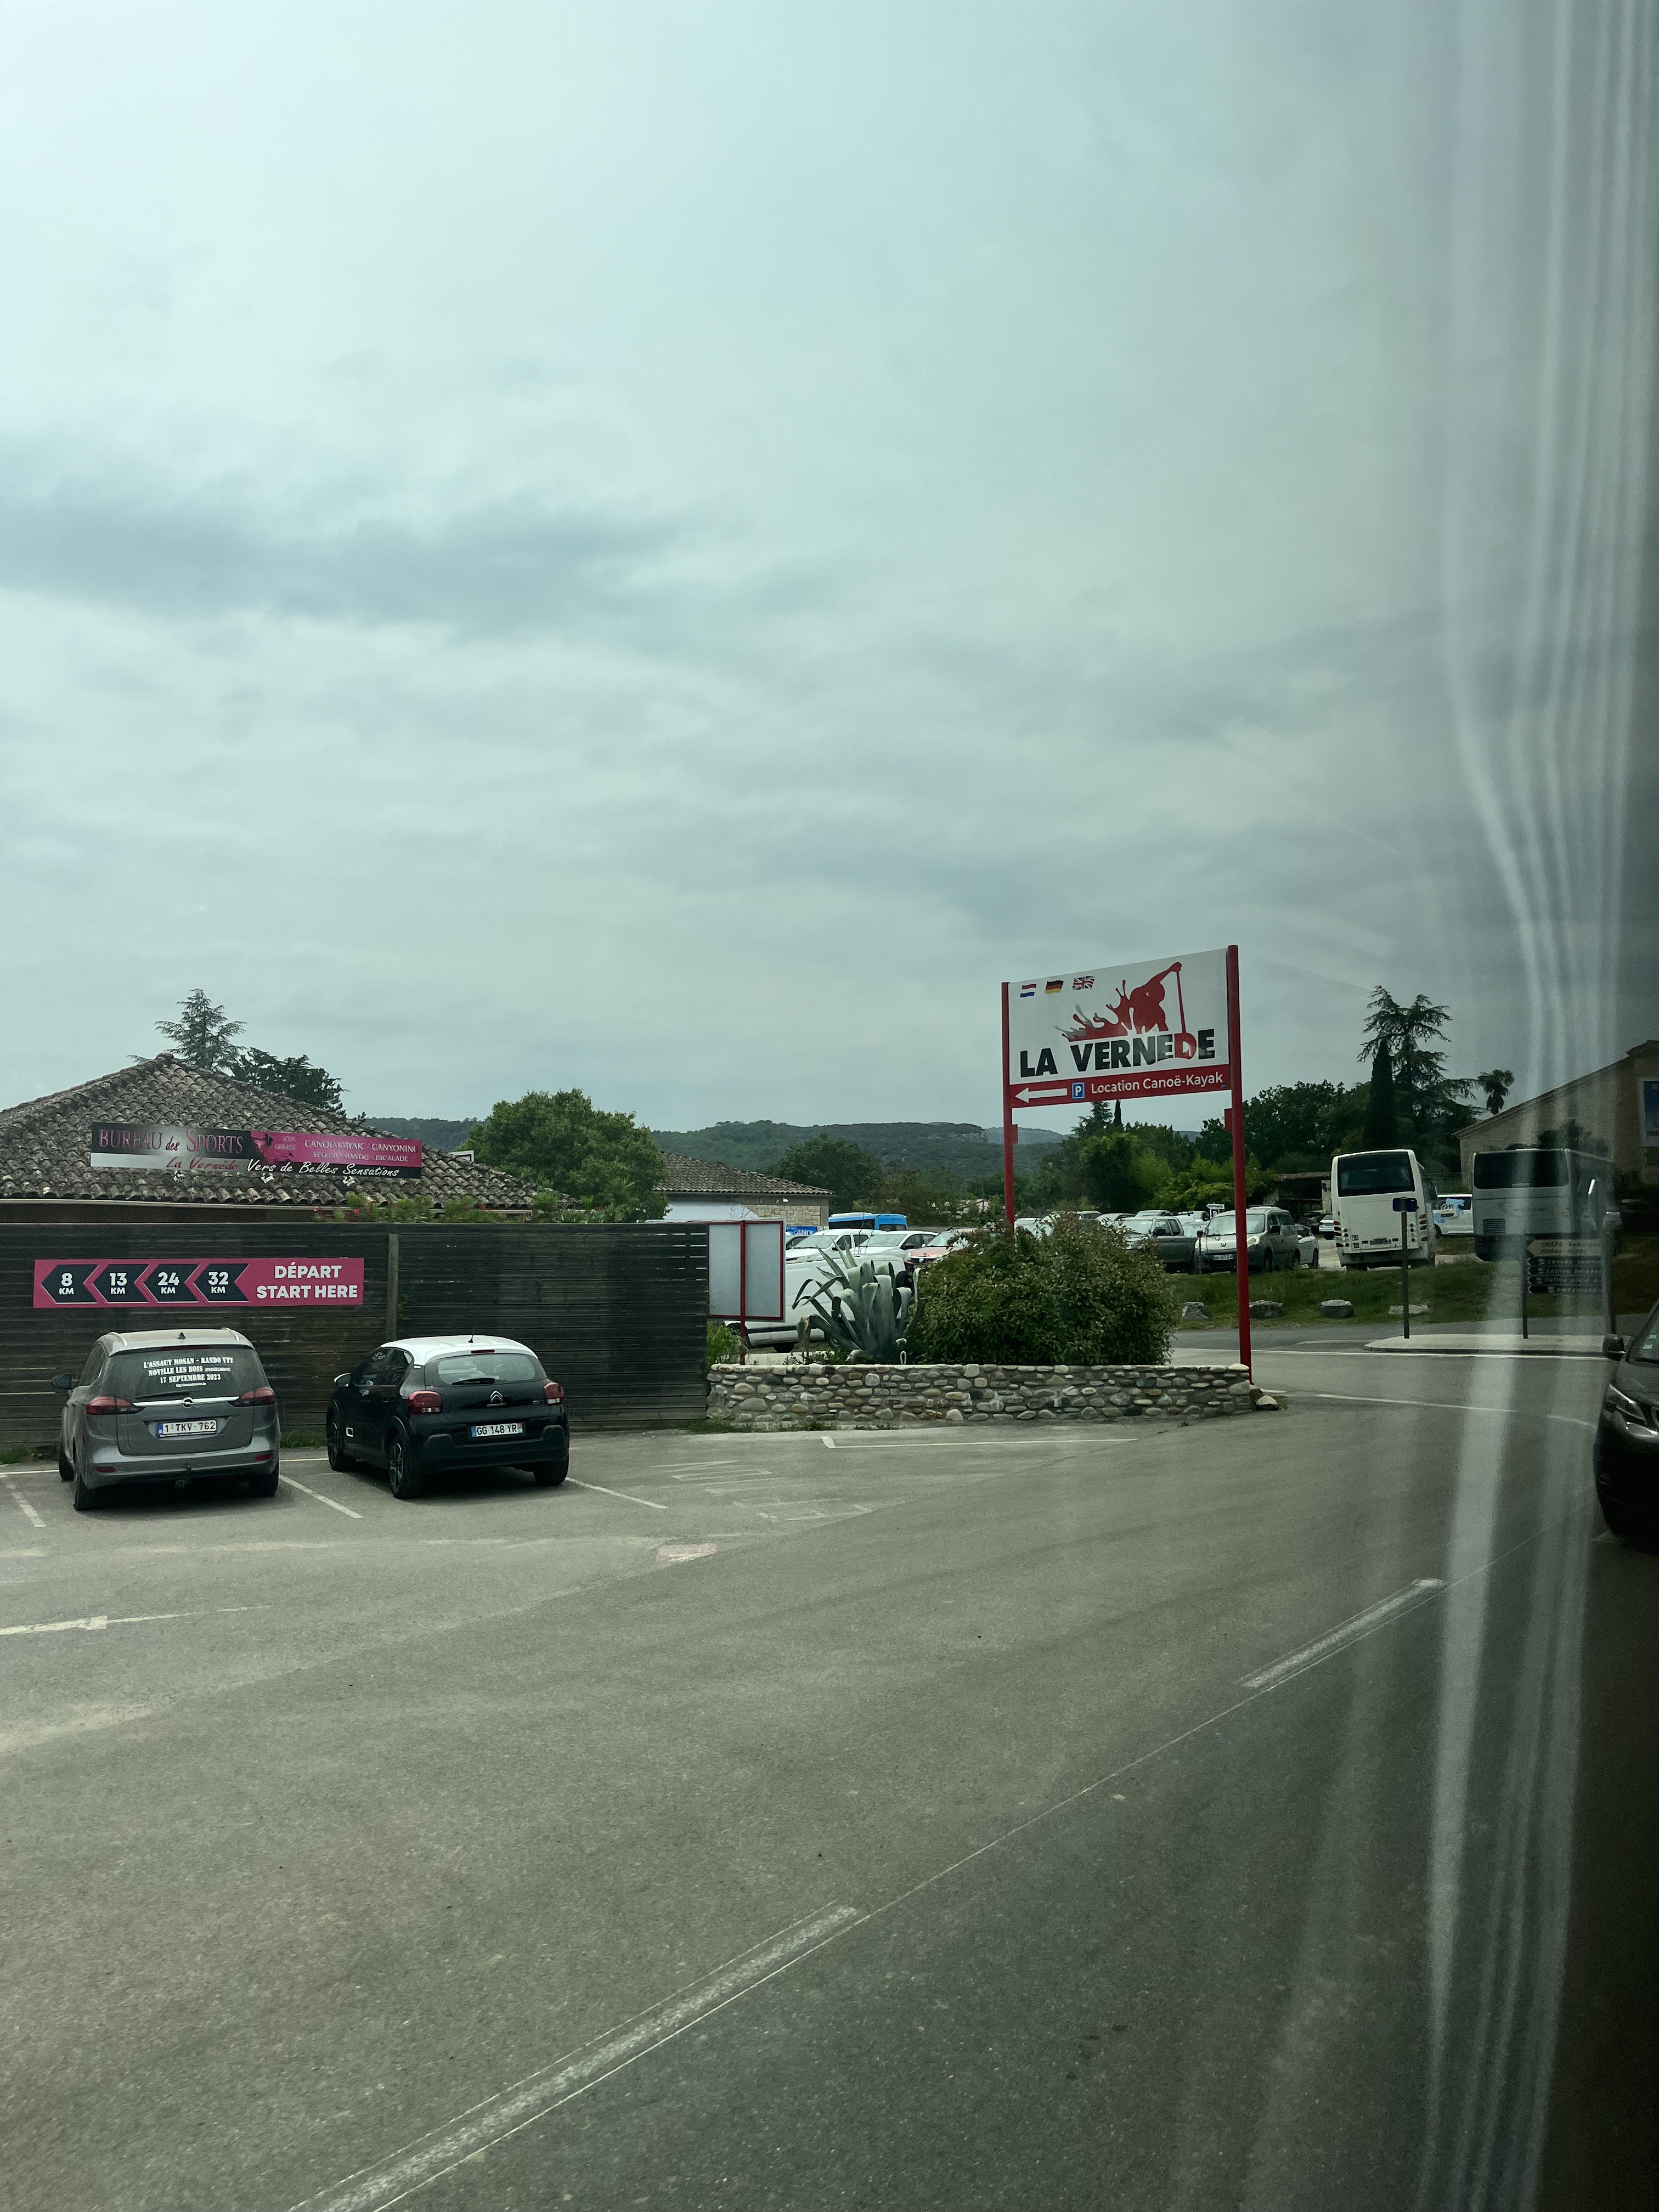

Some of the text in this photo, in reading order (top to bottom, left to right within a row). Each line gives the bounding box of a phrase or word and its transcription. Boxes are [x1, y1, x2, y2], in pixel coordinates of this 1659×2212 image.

[1020, 1029, 1215, 1077] LA VERNEDE
[1091, 1080, 1139, 1094] Location
[1143, 1071, 1223, 1090] Canoë-Kayak
[99, 1129, 163, 1149] BUREAU
[166, 1136, 180, 1151] des
[166, 1156, 182, 1168] La
[246, 1159, 400, 1177] Vers de Belles Sensations
[275, 1262, 342, 1278] DÉPART
[61, 1272, 73, 1286] 8
[110, 1272, 127, 1286] 13
[157, 1272, 179, 1285] 24
[208, 1272, 229, 1285] 32
[256, 1285, 358, 1299] START HERE
[143, 1359, 173, 1369] L'ASSAUT
[148, 1367, 174, 1376] NOVILLE
[168, 1374, 205, 1383] SEPTEMBRE
